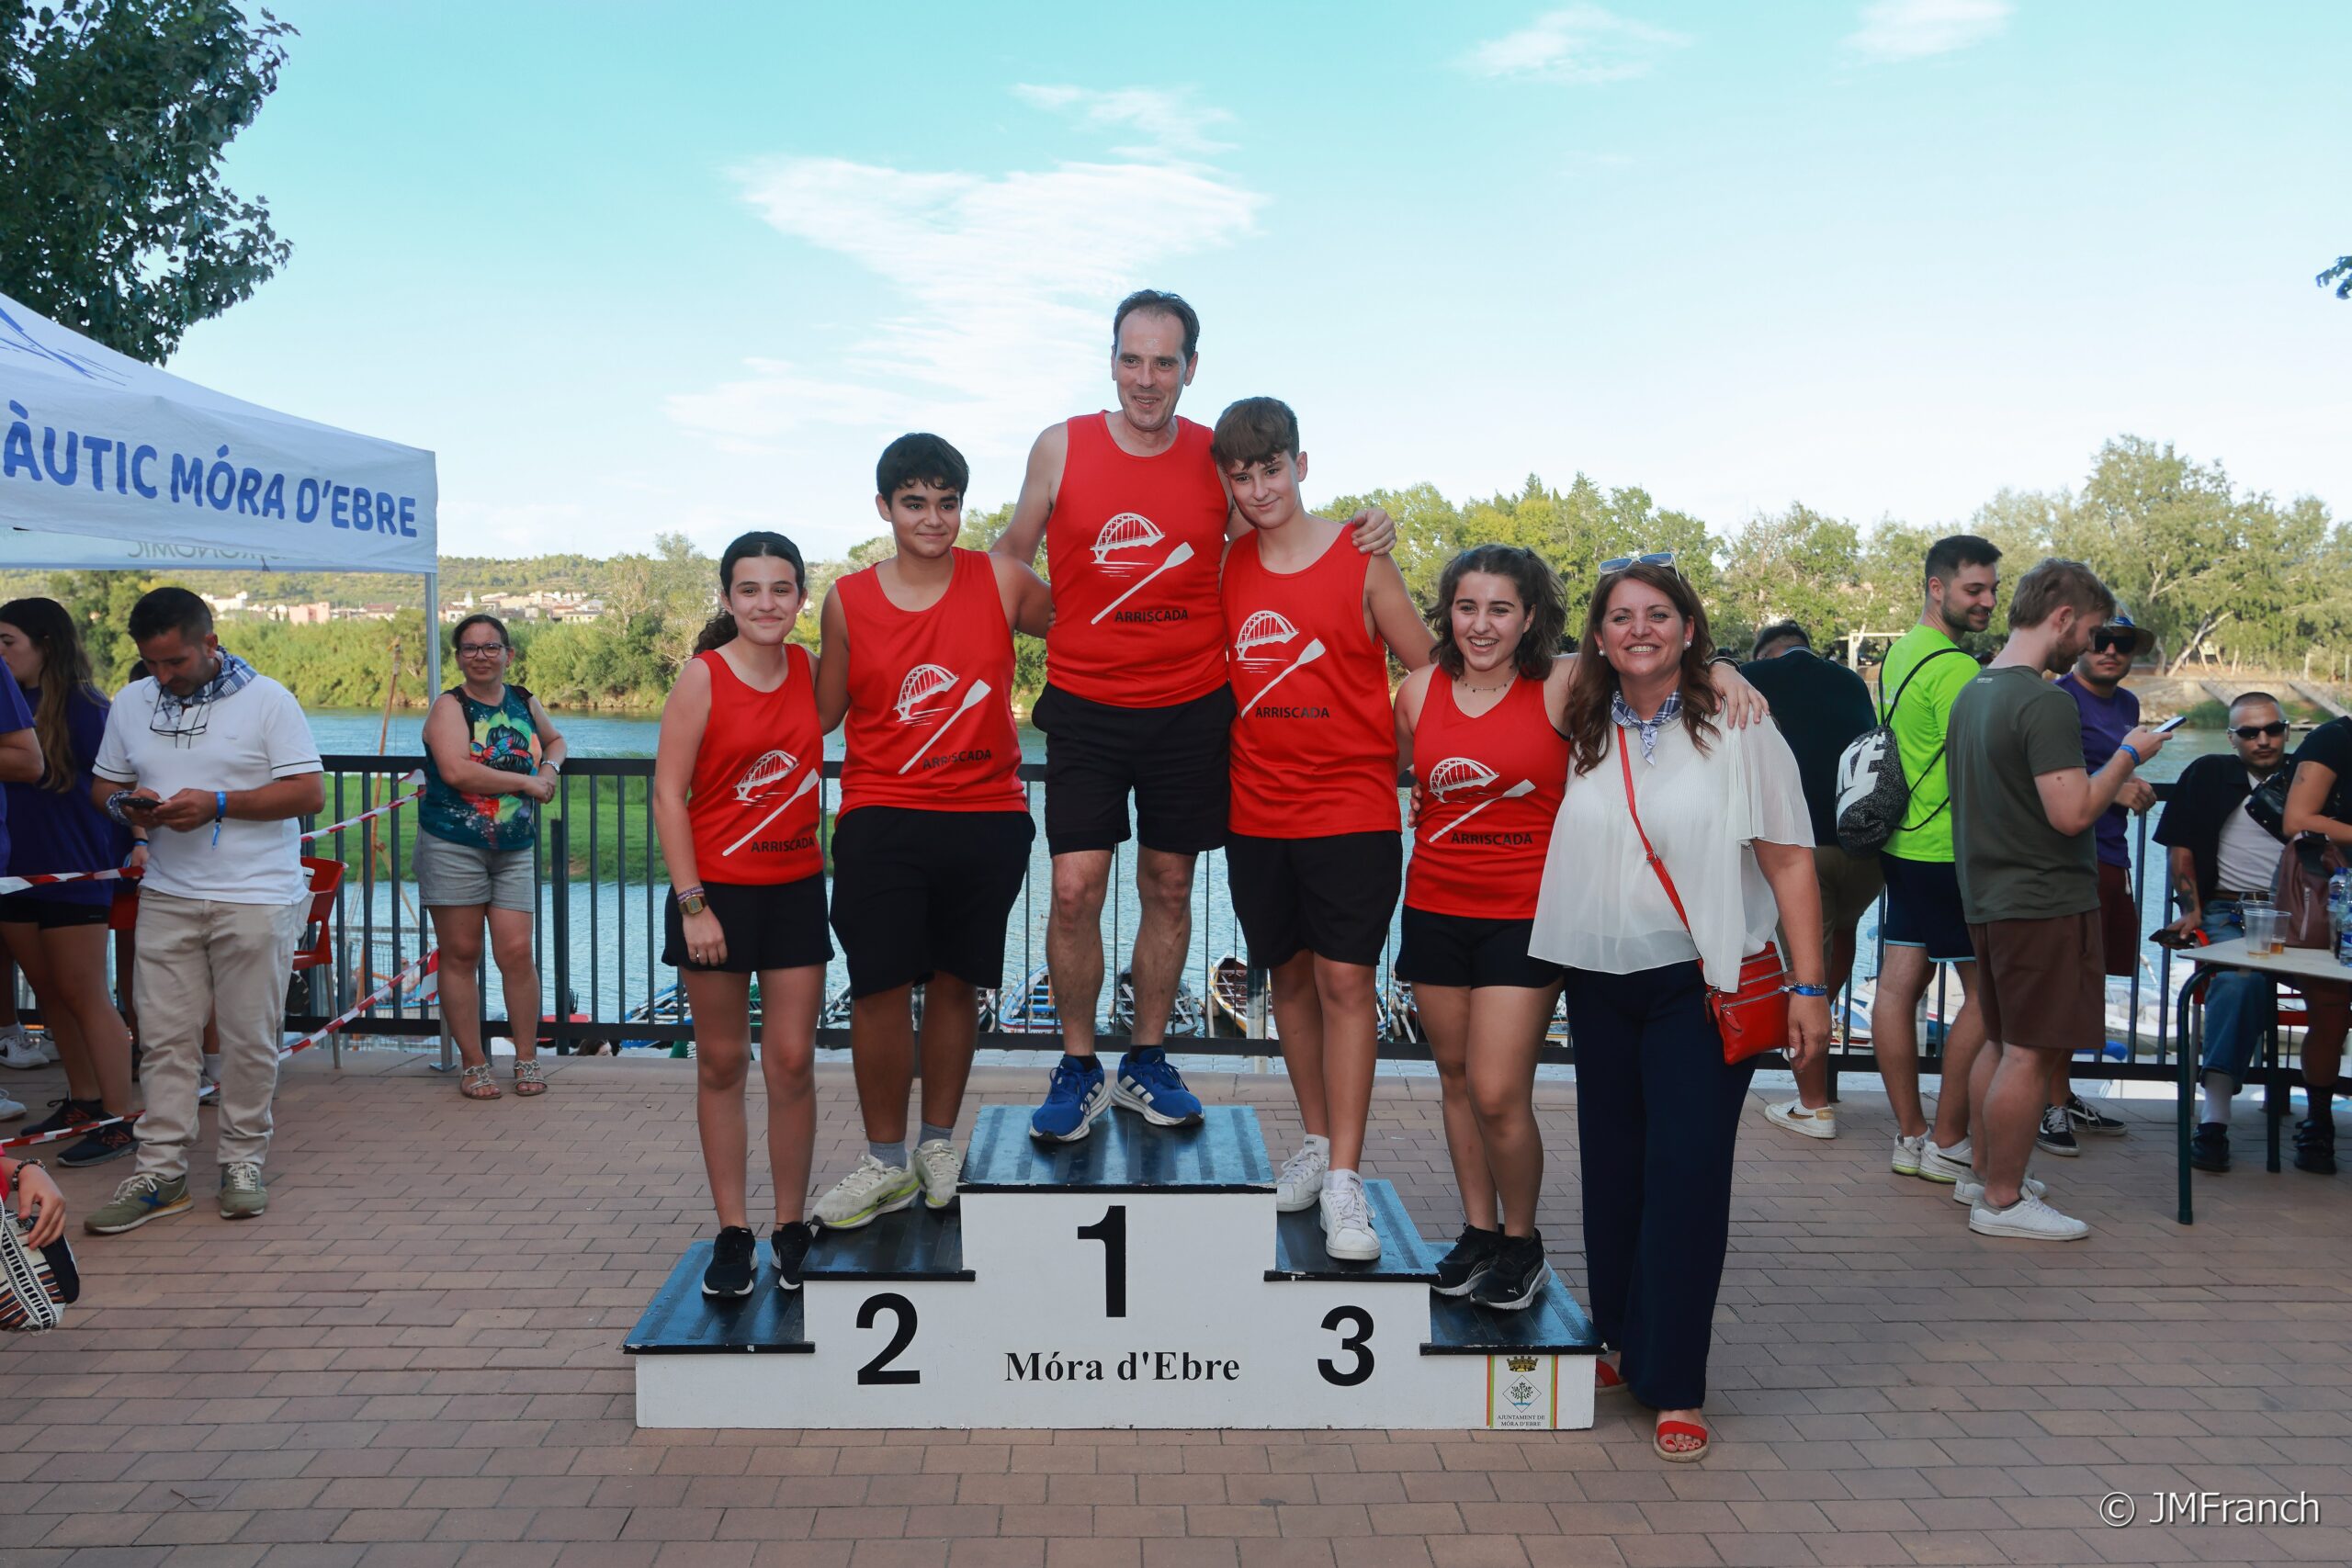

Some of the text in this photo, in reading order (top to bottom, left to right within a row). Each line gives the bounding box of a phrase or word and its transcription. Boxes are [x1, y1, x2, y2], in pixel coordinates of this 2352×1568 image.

[170, 444, 285, 520] MÓRA
[296, 478, 417, 537] D'EBRE
[1114, 609, 1189, 623] ARRISCADA
[1255, 705, 1330, 719] ARRISCADA
[922, 750, 992, 770] ARRISCADA
[751, 837, 815, 852] ARRISCADA
[1451, 832, 1533, 846] ARRISCADA
[1078, 1205, 1126, 1317] 1
[855, 1292, 921, 1385] 2
[1317, 1305, 1374, 1386] 3
[1004, 1351, 1240, 1382] Móra d'Ebre
